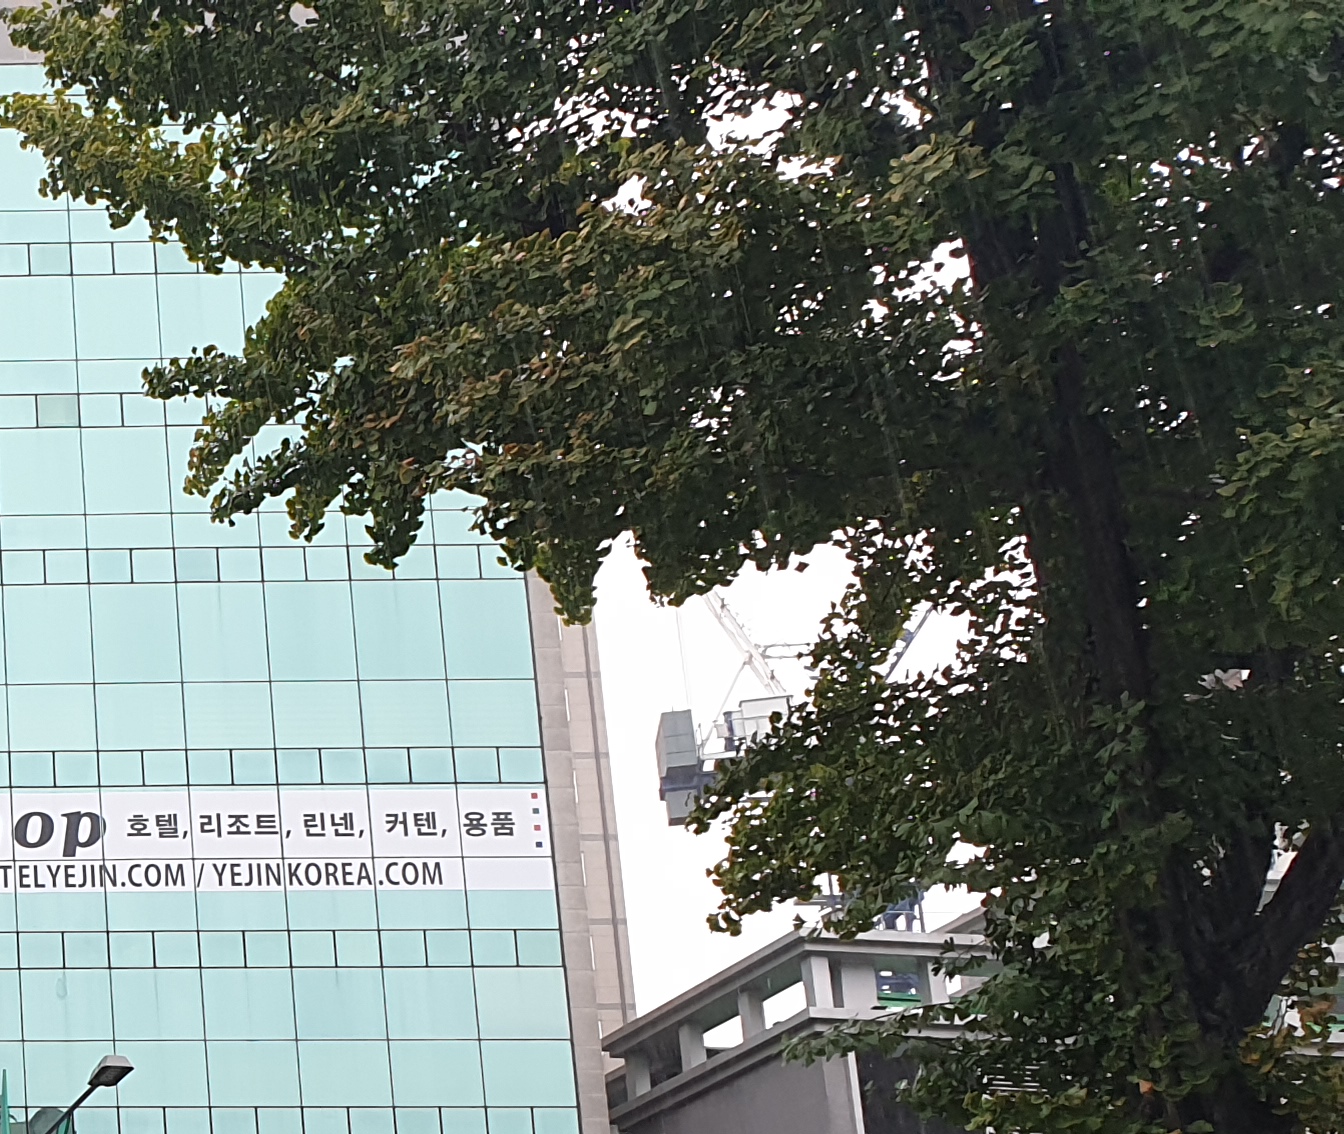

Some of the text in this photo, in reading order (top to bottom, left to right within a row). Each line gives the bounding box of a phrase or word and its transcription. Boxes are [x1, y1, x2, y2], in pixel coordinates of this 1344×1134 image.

[126, 813, 189, 840] 호텔,
[302, 812, 365, 840] 린넨,
[385, 811, 449, 840] 커텐,
[463, 811, 517, 838] 용품
[212, 862, 445, 888] YEJINKOREA.COM
